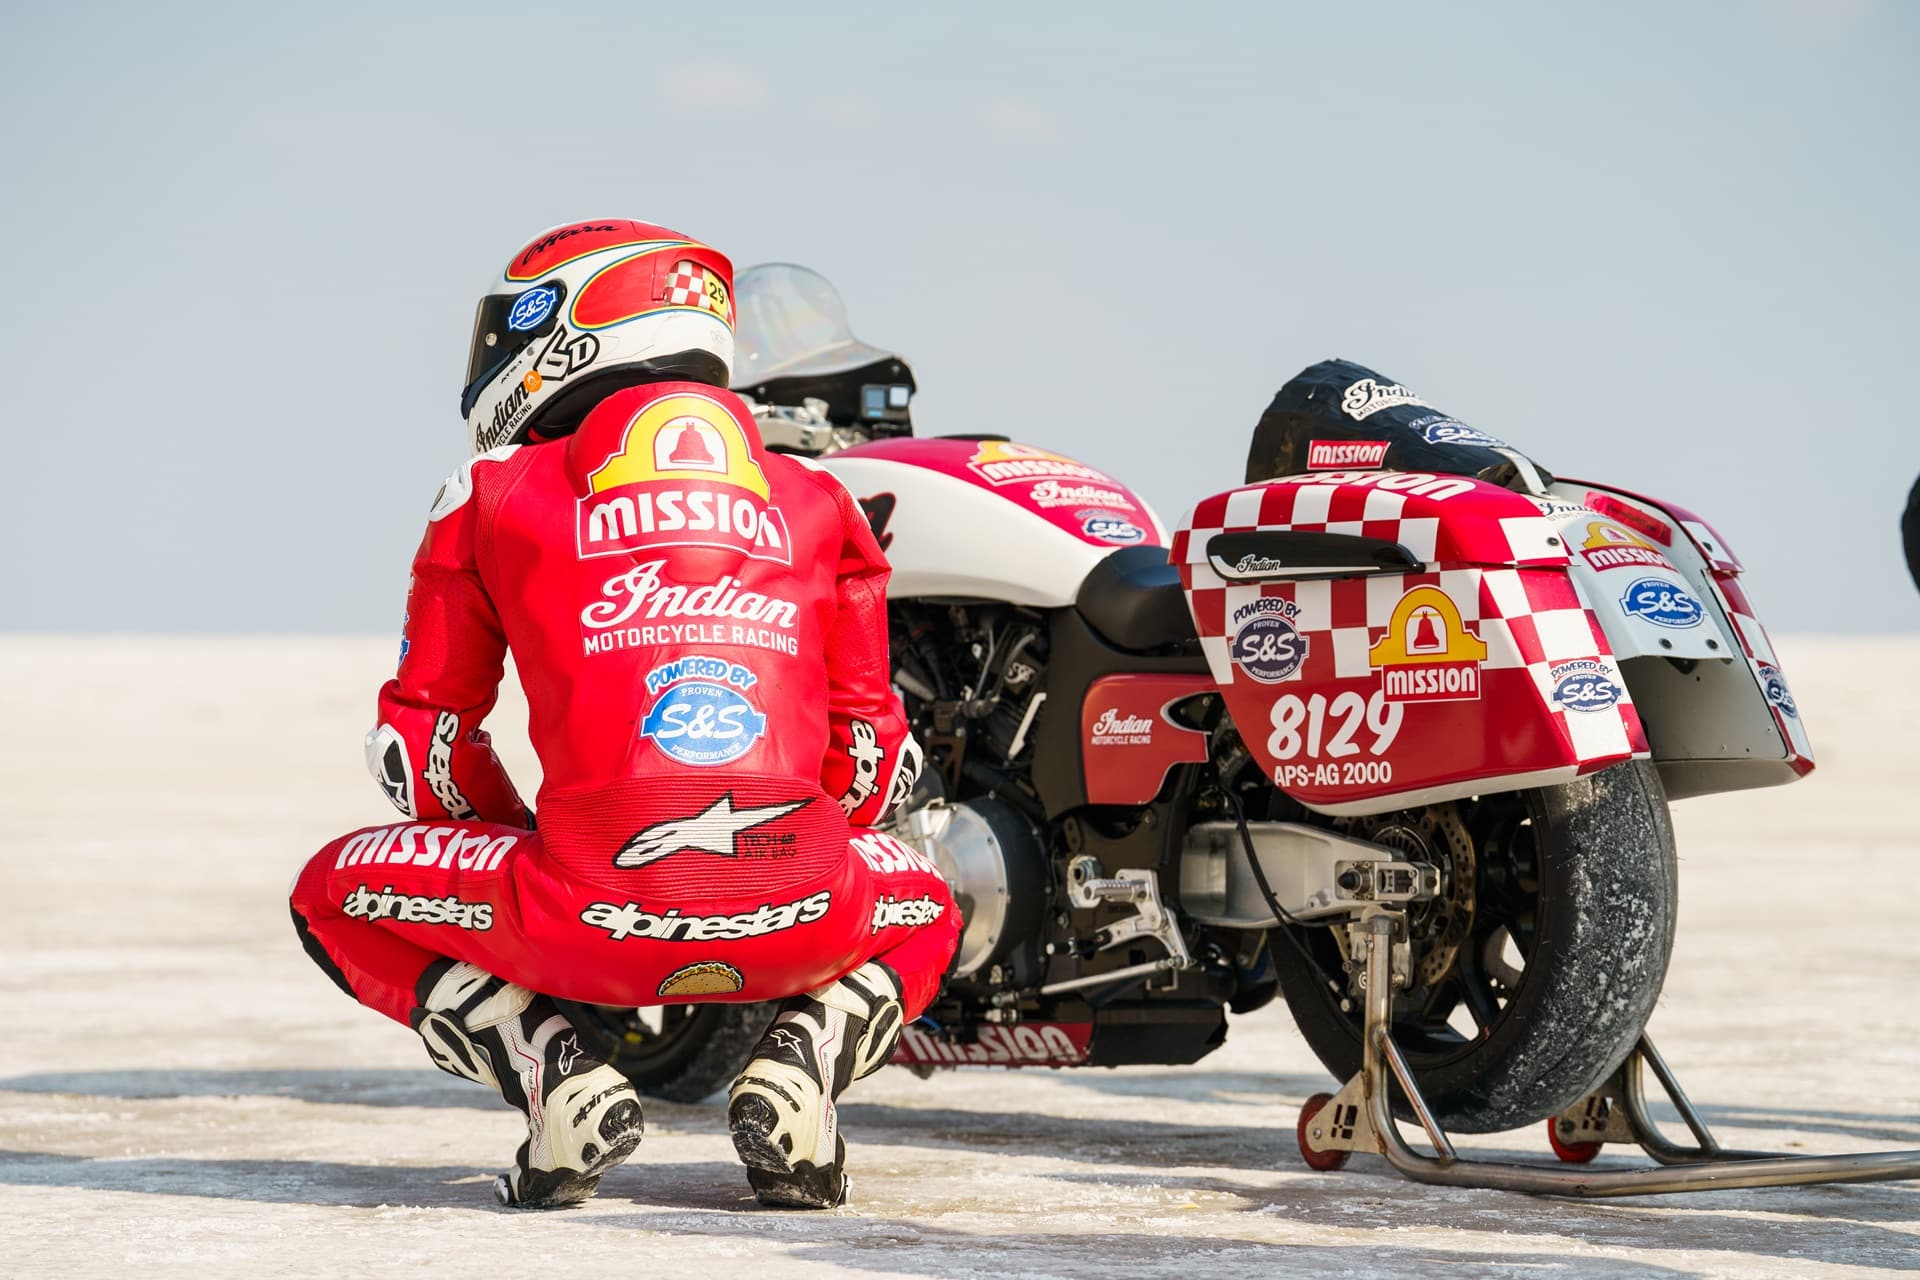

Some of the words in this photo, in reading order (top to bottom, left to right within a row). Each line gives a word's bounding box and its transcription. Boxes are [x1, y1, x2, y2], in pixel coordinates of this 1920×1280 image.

[709, 282, 724, 304] 29
[516, 293, 547, 324] S&S
[509, 403, 533, 429] RACING
[1312, 445, 1382, 464] MISSION
[589, 490, 782, 549] MISSION
[1236, 554, 1280, 573] Indian
[1588, 547, 1670, 567] MISSIO
[581, 560, 797, 629] Indian
[1637, 591, 1694, 613] S&S
[1233, 599, 1283, 624] POWERED
[1285, 603, 1302, 618] BY
[1253, 620, 1280, 630] PROVEN
[584, 624, 728, 656] MOTORCYCLE
[732, 626, 798, 656] RACING
[1241, 632, 1296, 663] S&S
[646, 657, 728, 693] POWERED
[729, 665, 757, 690] BY
[1386, 667, 1475, 696] MISSION
[1551, 661, 1596, 678] POWERED
[1598, 663, 1613, 674] BY
[681, 687, 722, 697] PROVEN
[1562, 682, 1612, 703] S&S
[656, 703, 748, 739] S&S
[1093, 708, 1152, 735] Indian
[1267, 689, 1404, 760] 8129
[671, 743, 741, 760] PERFORMANCE
[1274, 763, 1339, 788] APS-AG
[1343, 761, 1392, 785] 2000
[335, 826, 518, 871] MISSION
[342, 885, 493, 930] alpinestars
[580, 891, 830, 940] alpinestars
